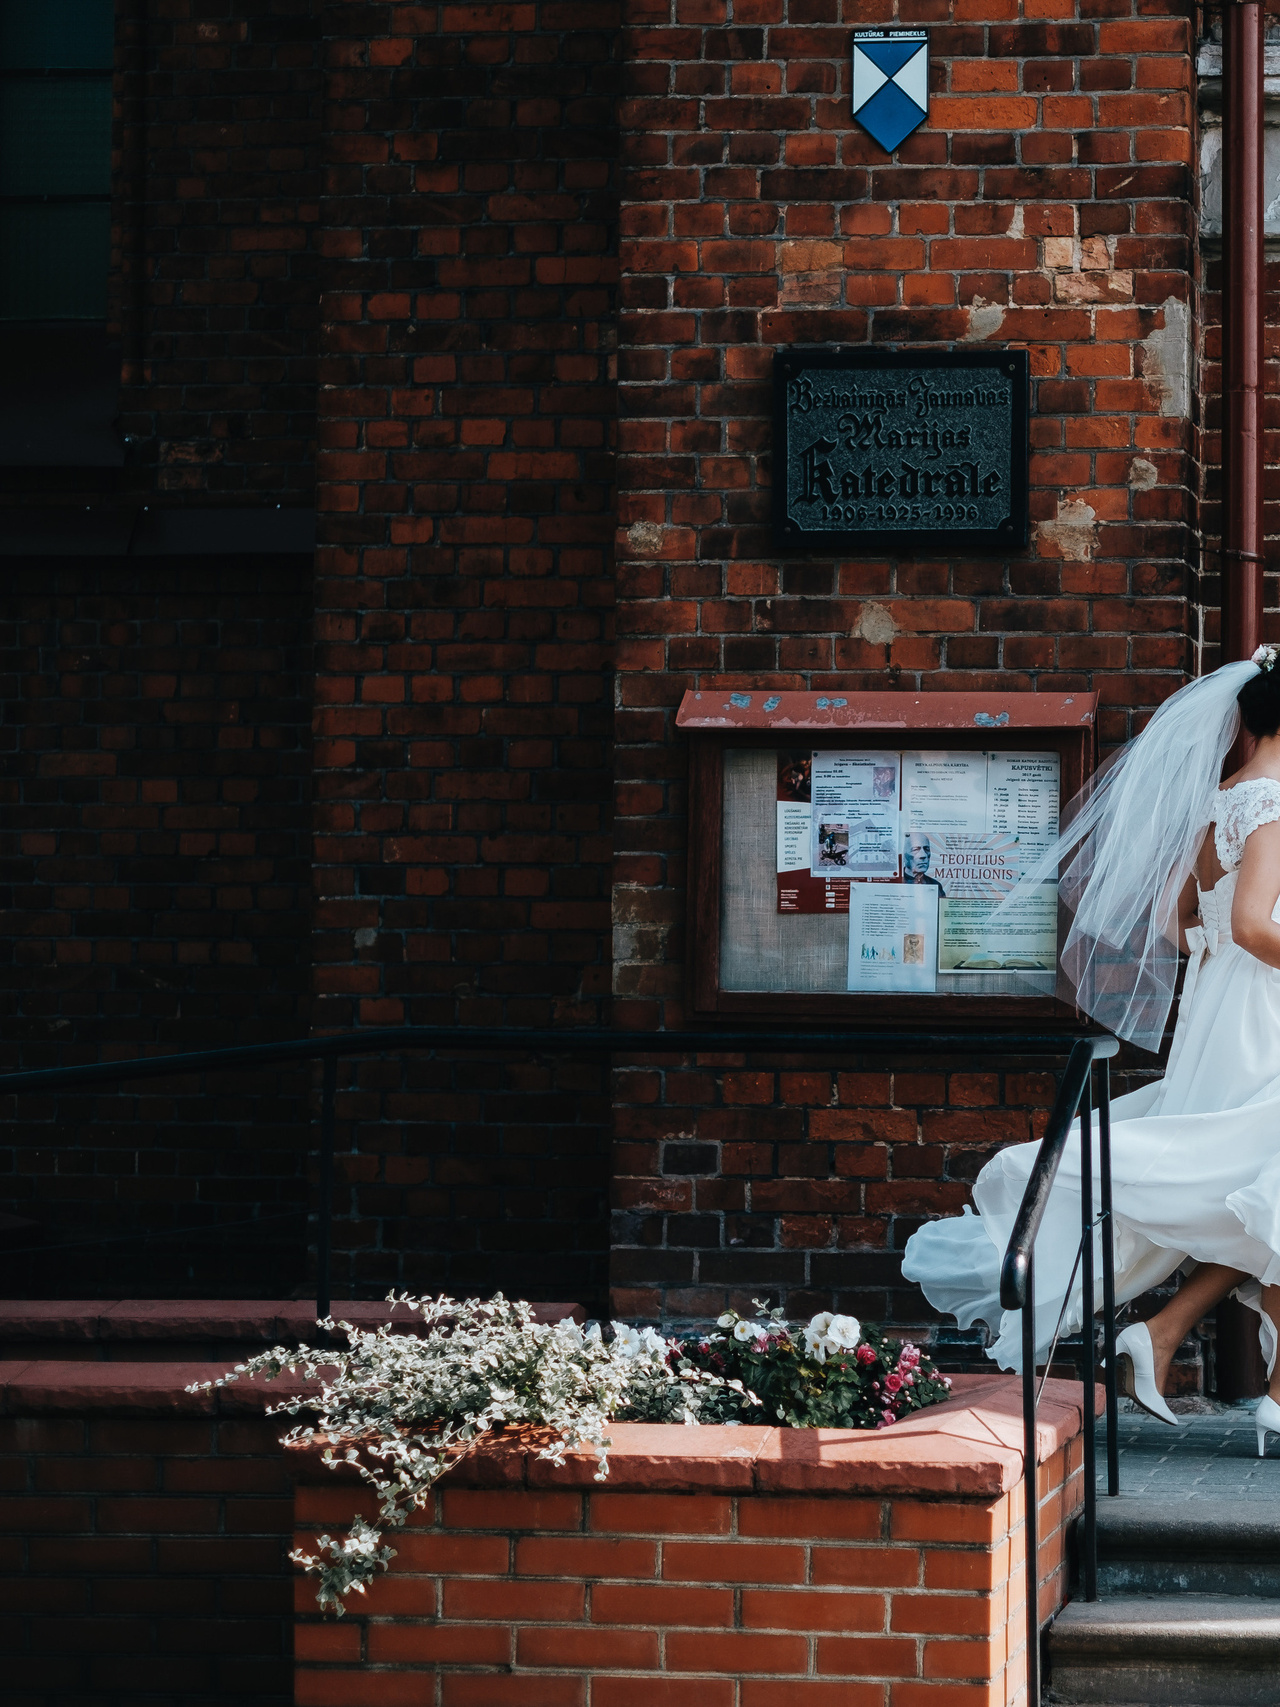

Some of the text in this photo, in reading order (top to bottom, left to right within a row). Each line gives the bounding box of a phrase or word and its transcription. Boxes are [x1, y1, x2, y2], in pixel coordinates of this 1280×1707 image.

[909, 376, 1010, 418] Jaunavas
[838, 412, 973, 461] Marijas
[792, 436, 1002, 505] Katedrāle
[1011, 764, 1053, 772] KAPUSVĒTKI
[940, 853, 1005, 866] TEOFILIUS
[934, 867, 1013, 880] MATULIONIS
